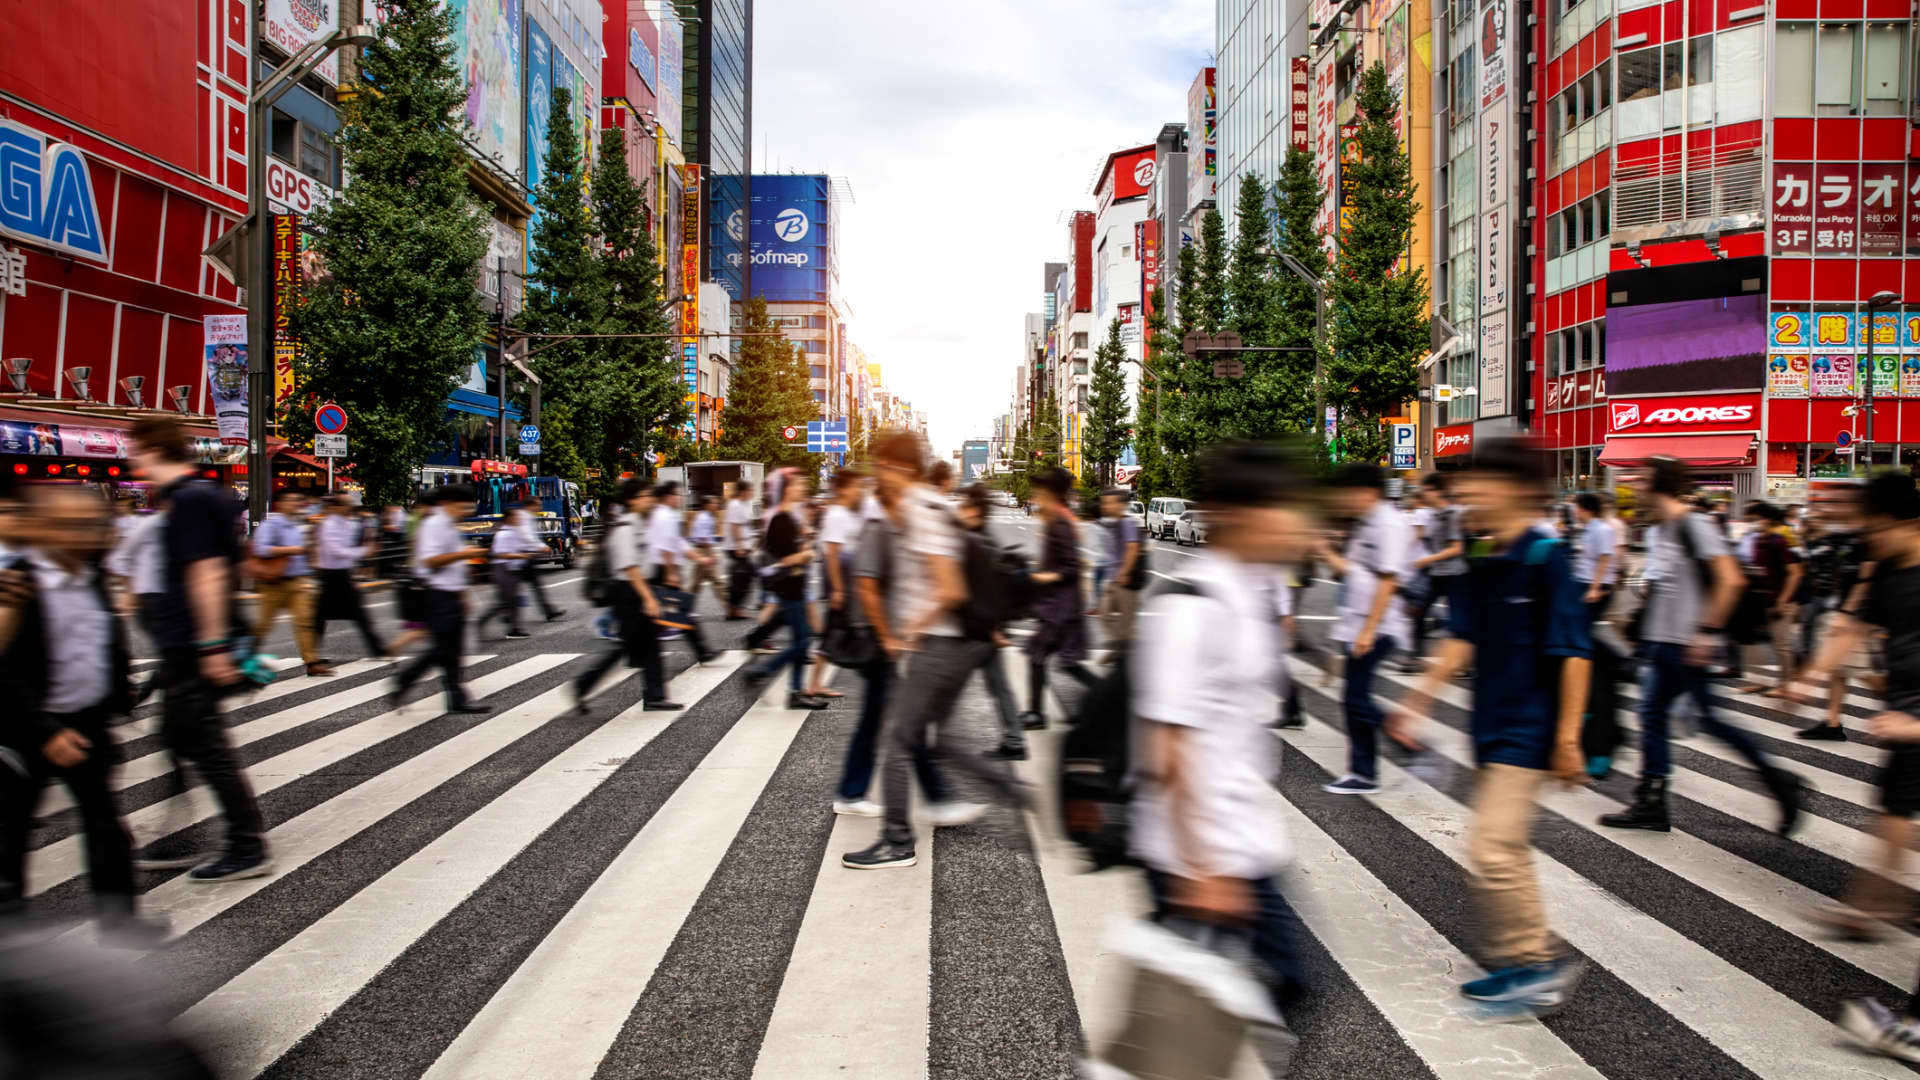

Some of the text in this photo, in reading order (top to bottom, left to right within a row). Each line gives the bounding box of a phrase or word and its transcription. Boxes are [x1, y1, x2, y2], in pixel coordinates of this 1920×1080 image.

[269, 19, 287, 46] BIG
[1489, 122, 1499, 204] Anime
[268, 163, 311, 211] GPS
[1776, 173, 1920, 208] カラオ
[1773, 214, 1811, 223] Karaoke
[1831, 215, 1854, 224] Party
[1882, 214, 1897, 222] OK
[1777, 229, 1808, 247] 3F
[1816, 229, 1854, 248] 受付
[1489, 212, 1499, 288] Plaza
[1561, 373, 1605, 405] ゲーム
[1643, 405, 1754, 424] ADORES
[521, 430, 537, 438] 437
[1398, 428, 1411, 445] P
[1394, 456, 1405, 464] IN
